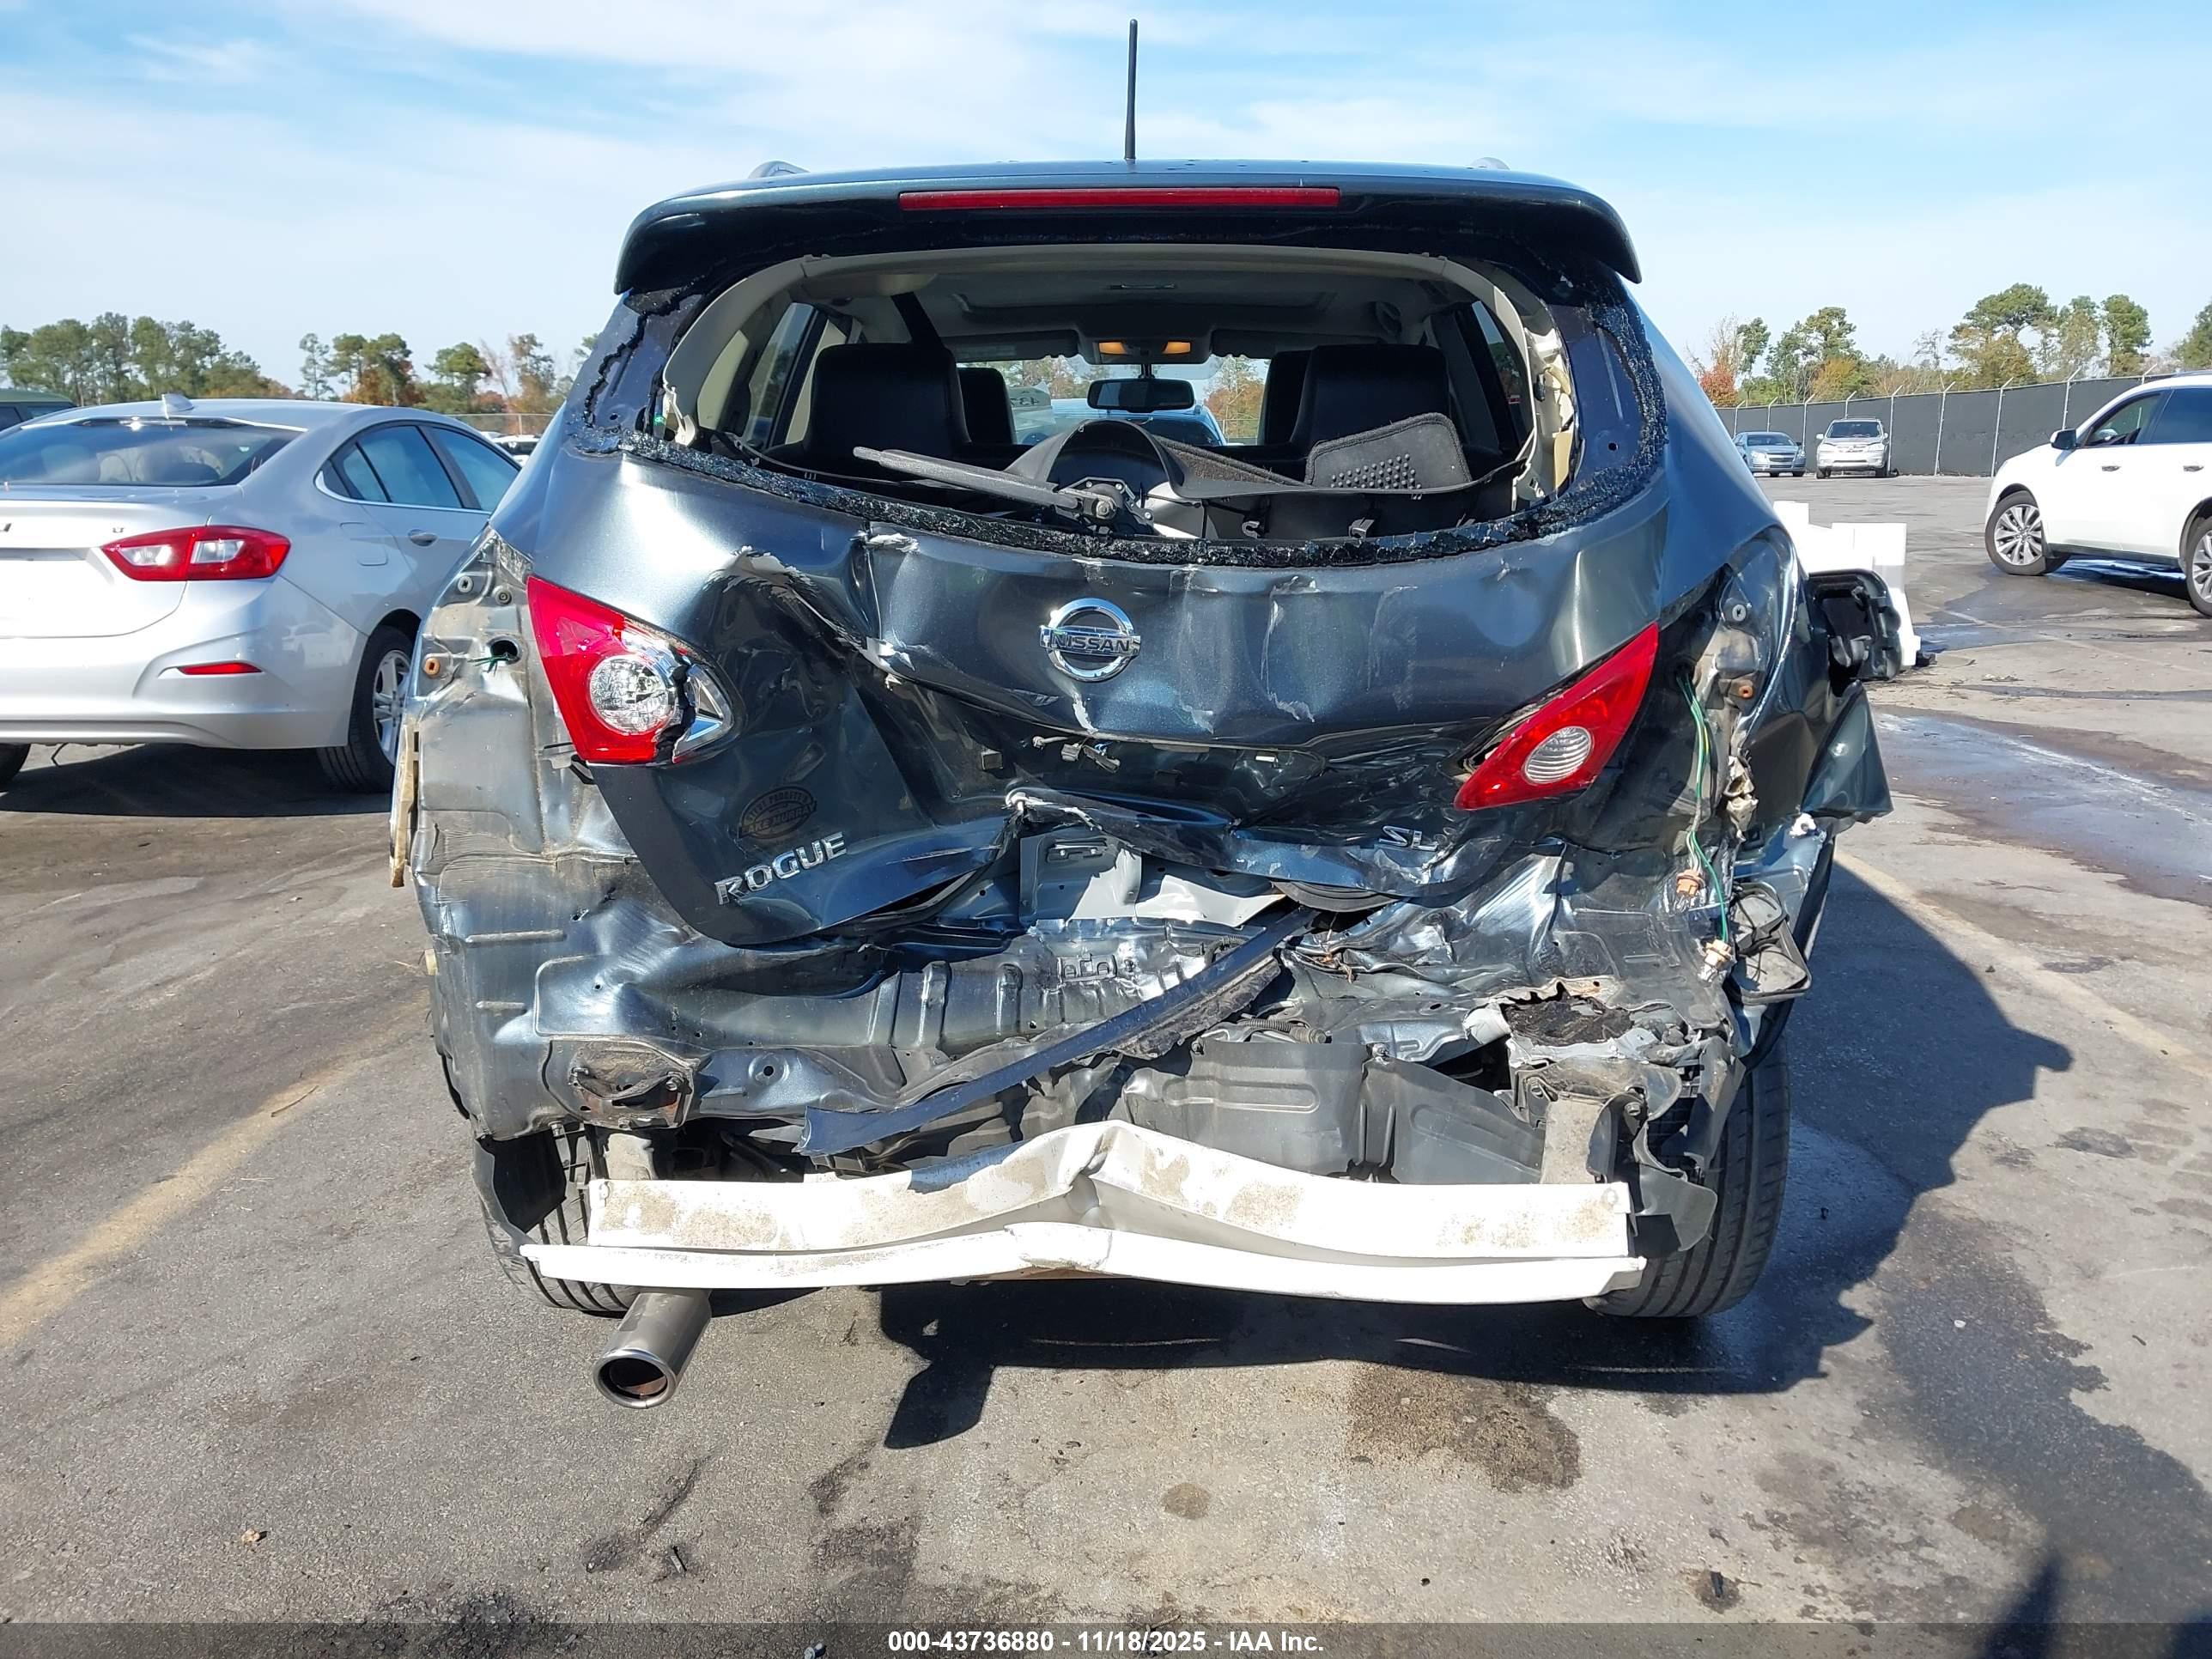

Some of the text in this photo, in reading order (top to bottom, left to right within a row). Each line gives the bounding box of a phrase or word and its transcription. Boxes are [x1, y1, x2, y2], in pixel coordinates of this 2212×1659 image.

[1051, 632, 1130, 653] NISSAN
[1378, 825, 1438, 851] SL
[714, 831, 848, 907] ROGUE
